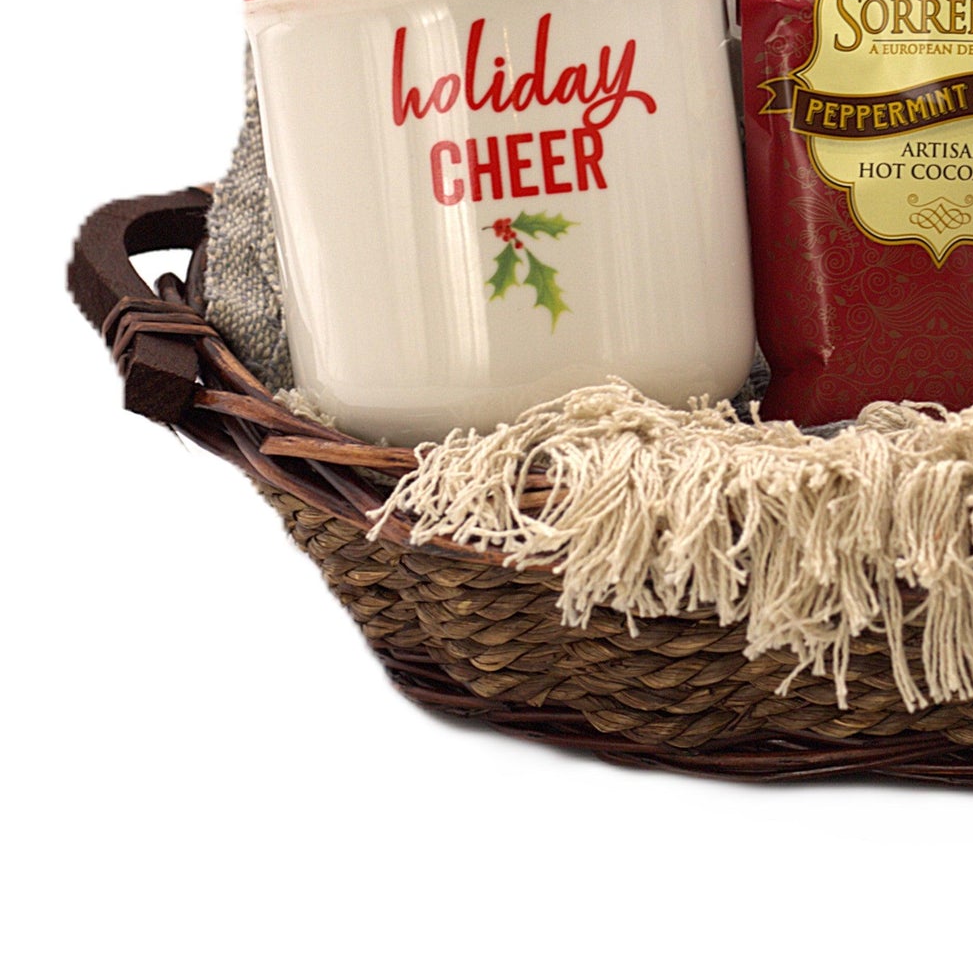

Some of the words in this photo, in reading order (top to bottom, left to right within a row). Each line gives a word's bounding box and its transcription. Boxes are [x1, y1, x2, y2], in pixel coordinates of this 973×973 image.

[392, 12, 657, 129] holiday
[869, 44, 879, 56] A
[883, 43, 954, 56] EUROPEAN
[805, 83, 970, 131] PEPPERMINT
[430, 127, 608, 207] CHEER
[859, 162, 905, 179] HOT
